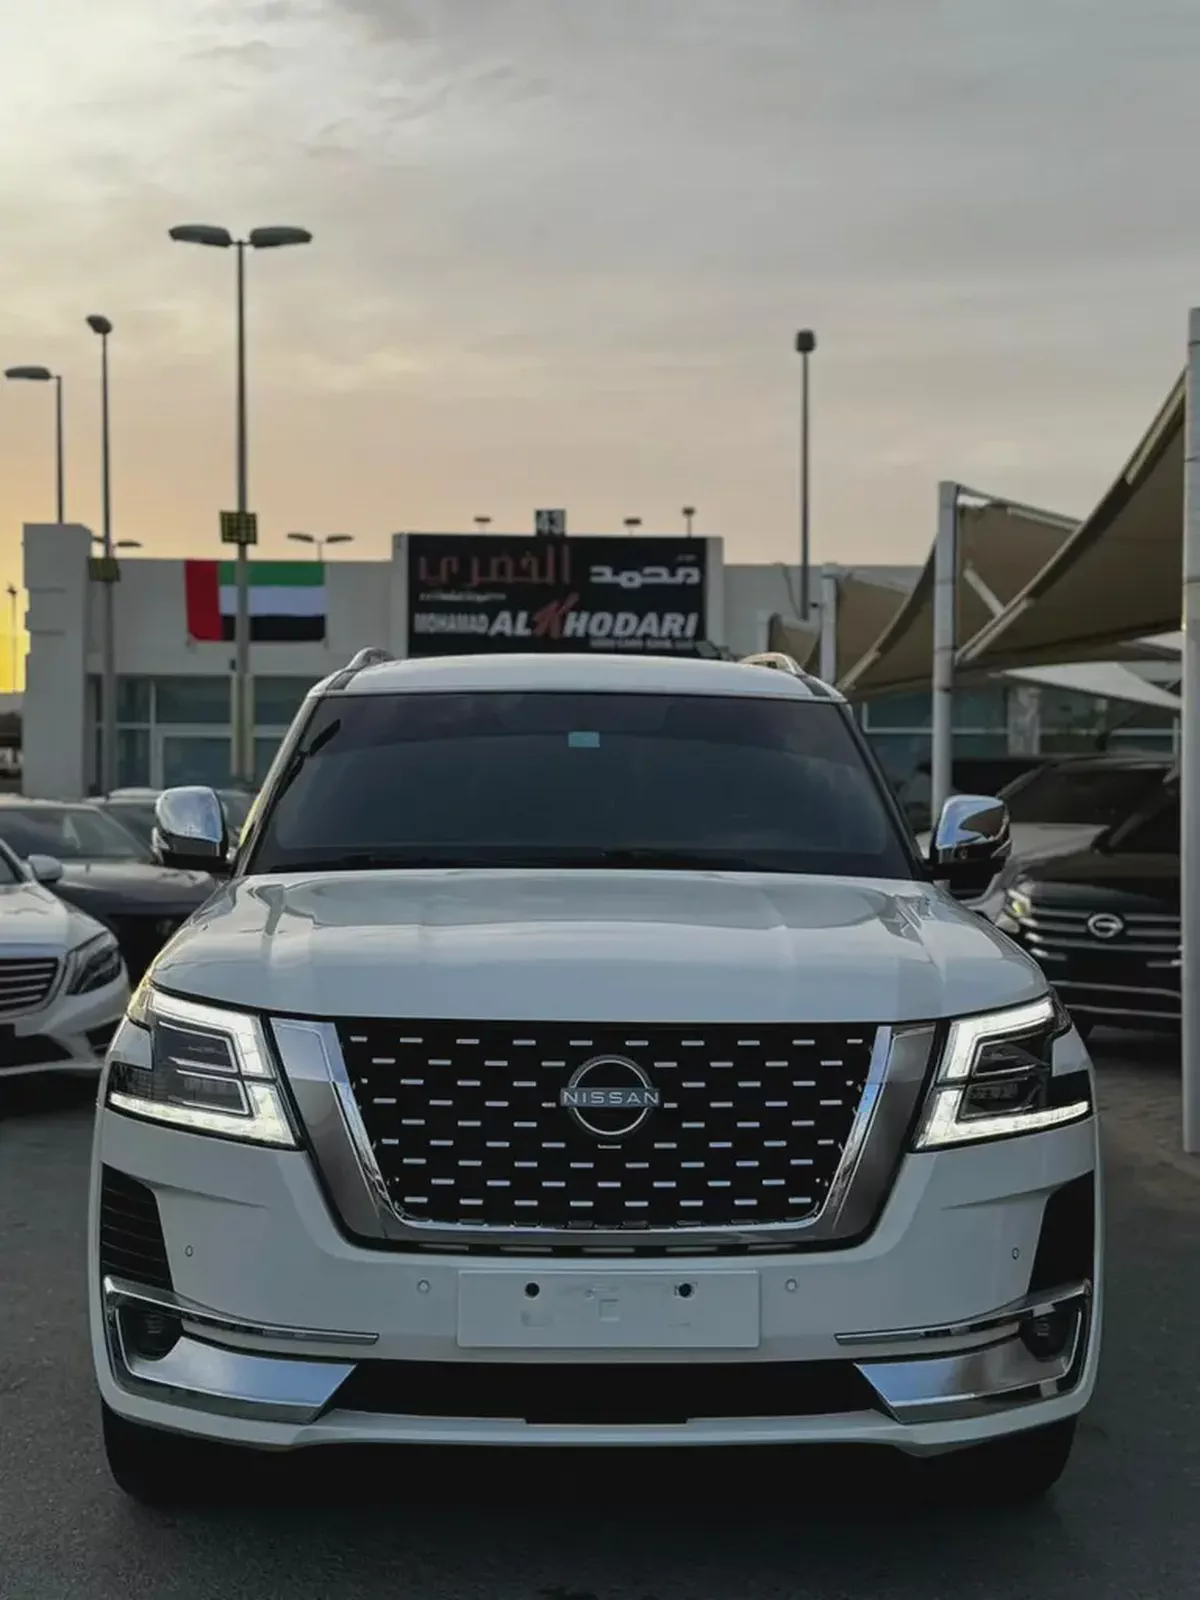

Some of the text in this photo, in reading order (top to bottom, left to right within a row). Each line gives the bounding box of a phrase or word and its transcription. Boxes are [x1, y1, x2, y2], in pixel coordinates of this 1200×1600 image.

[589, 565, 701, 589] محمد
[488, 610, 532, 637] AL
[563, 1091, 659, 1104] NISSAN
